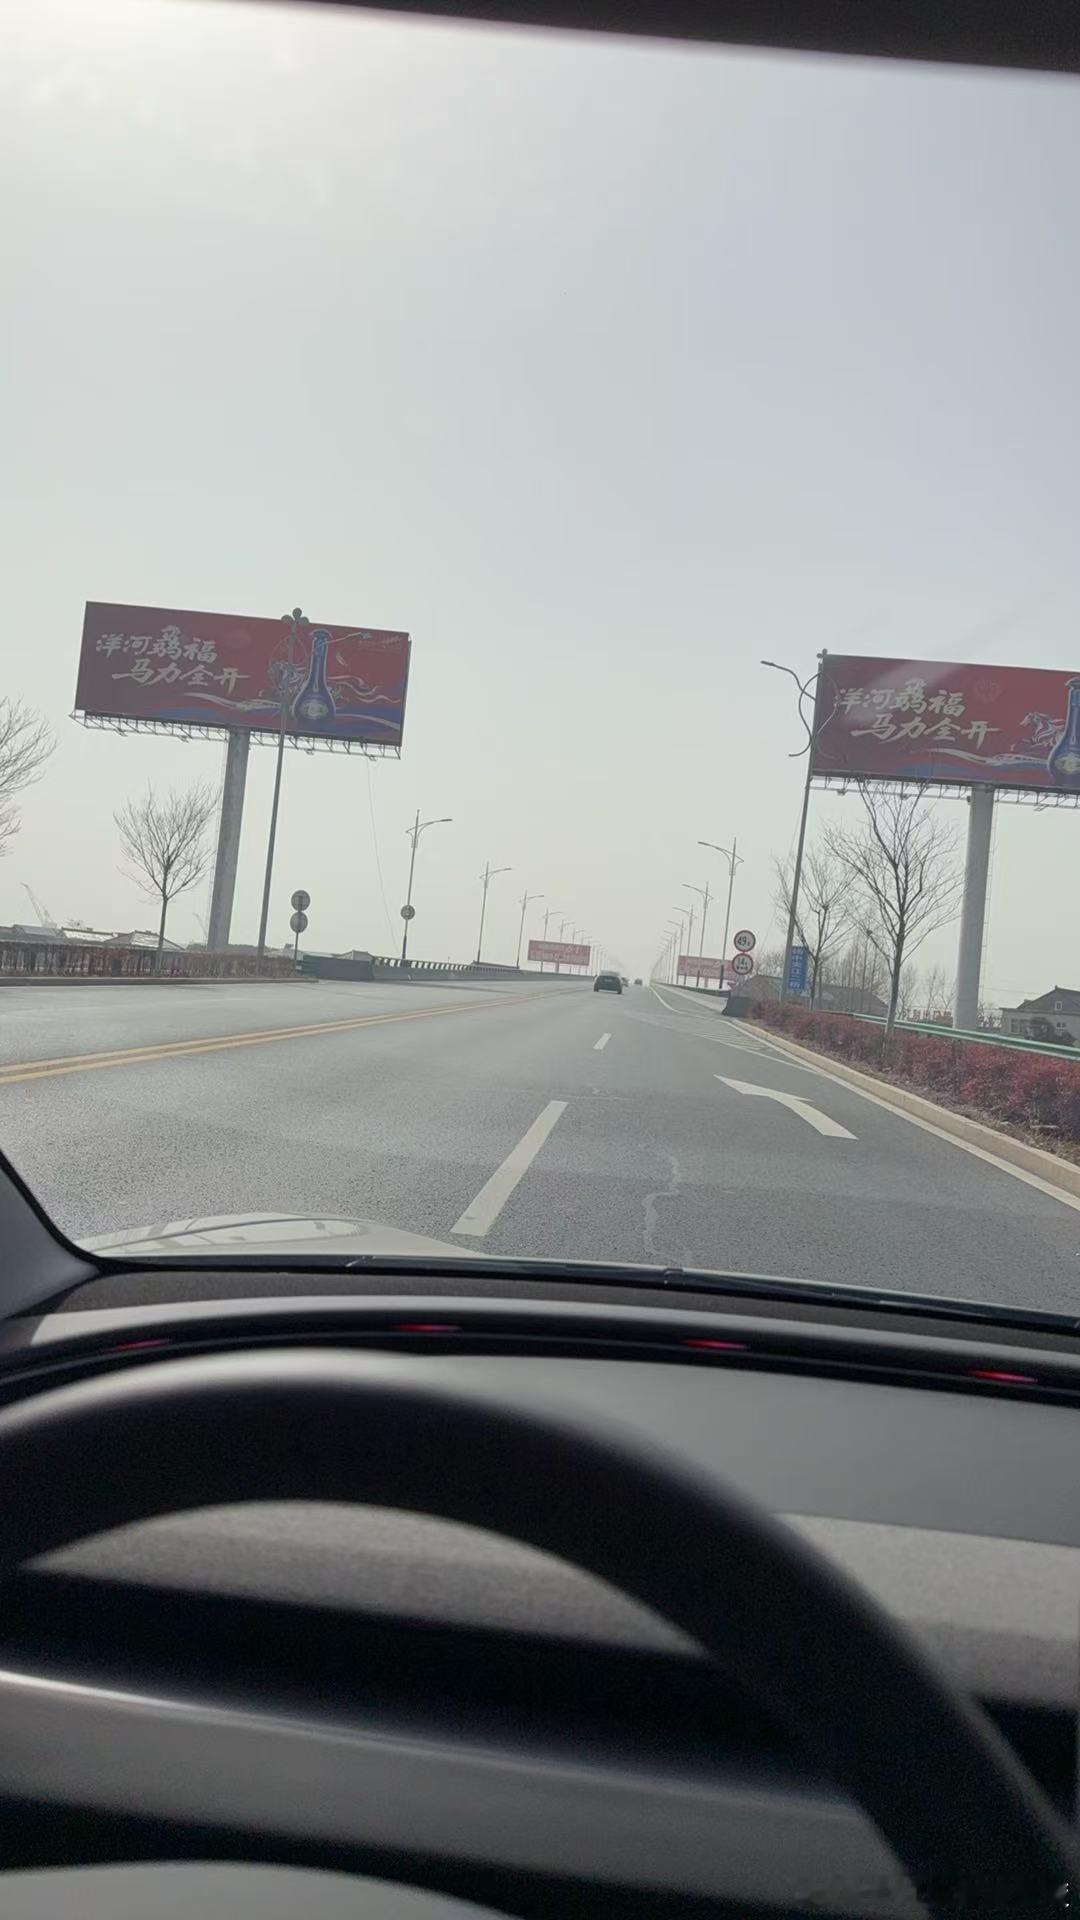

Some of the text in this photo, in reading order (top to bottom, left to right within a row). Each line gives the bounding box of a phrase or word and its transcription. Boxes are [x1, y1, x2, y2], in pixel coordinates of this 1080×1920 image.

[112, 658, 251, 696] 马力全开
[850, 713, 1002, 750] 马力全开
